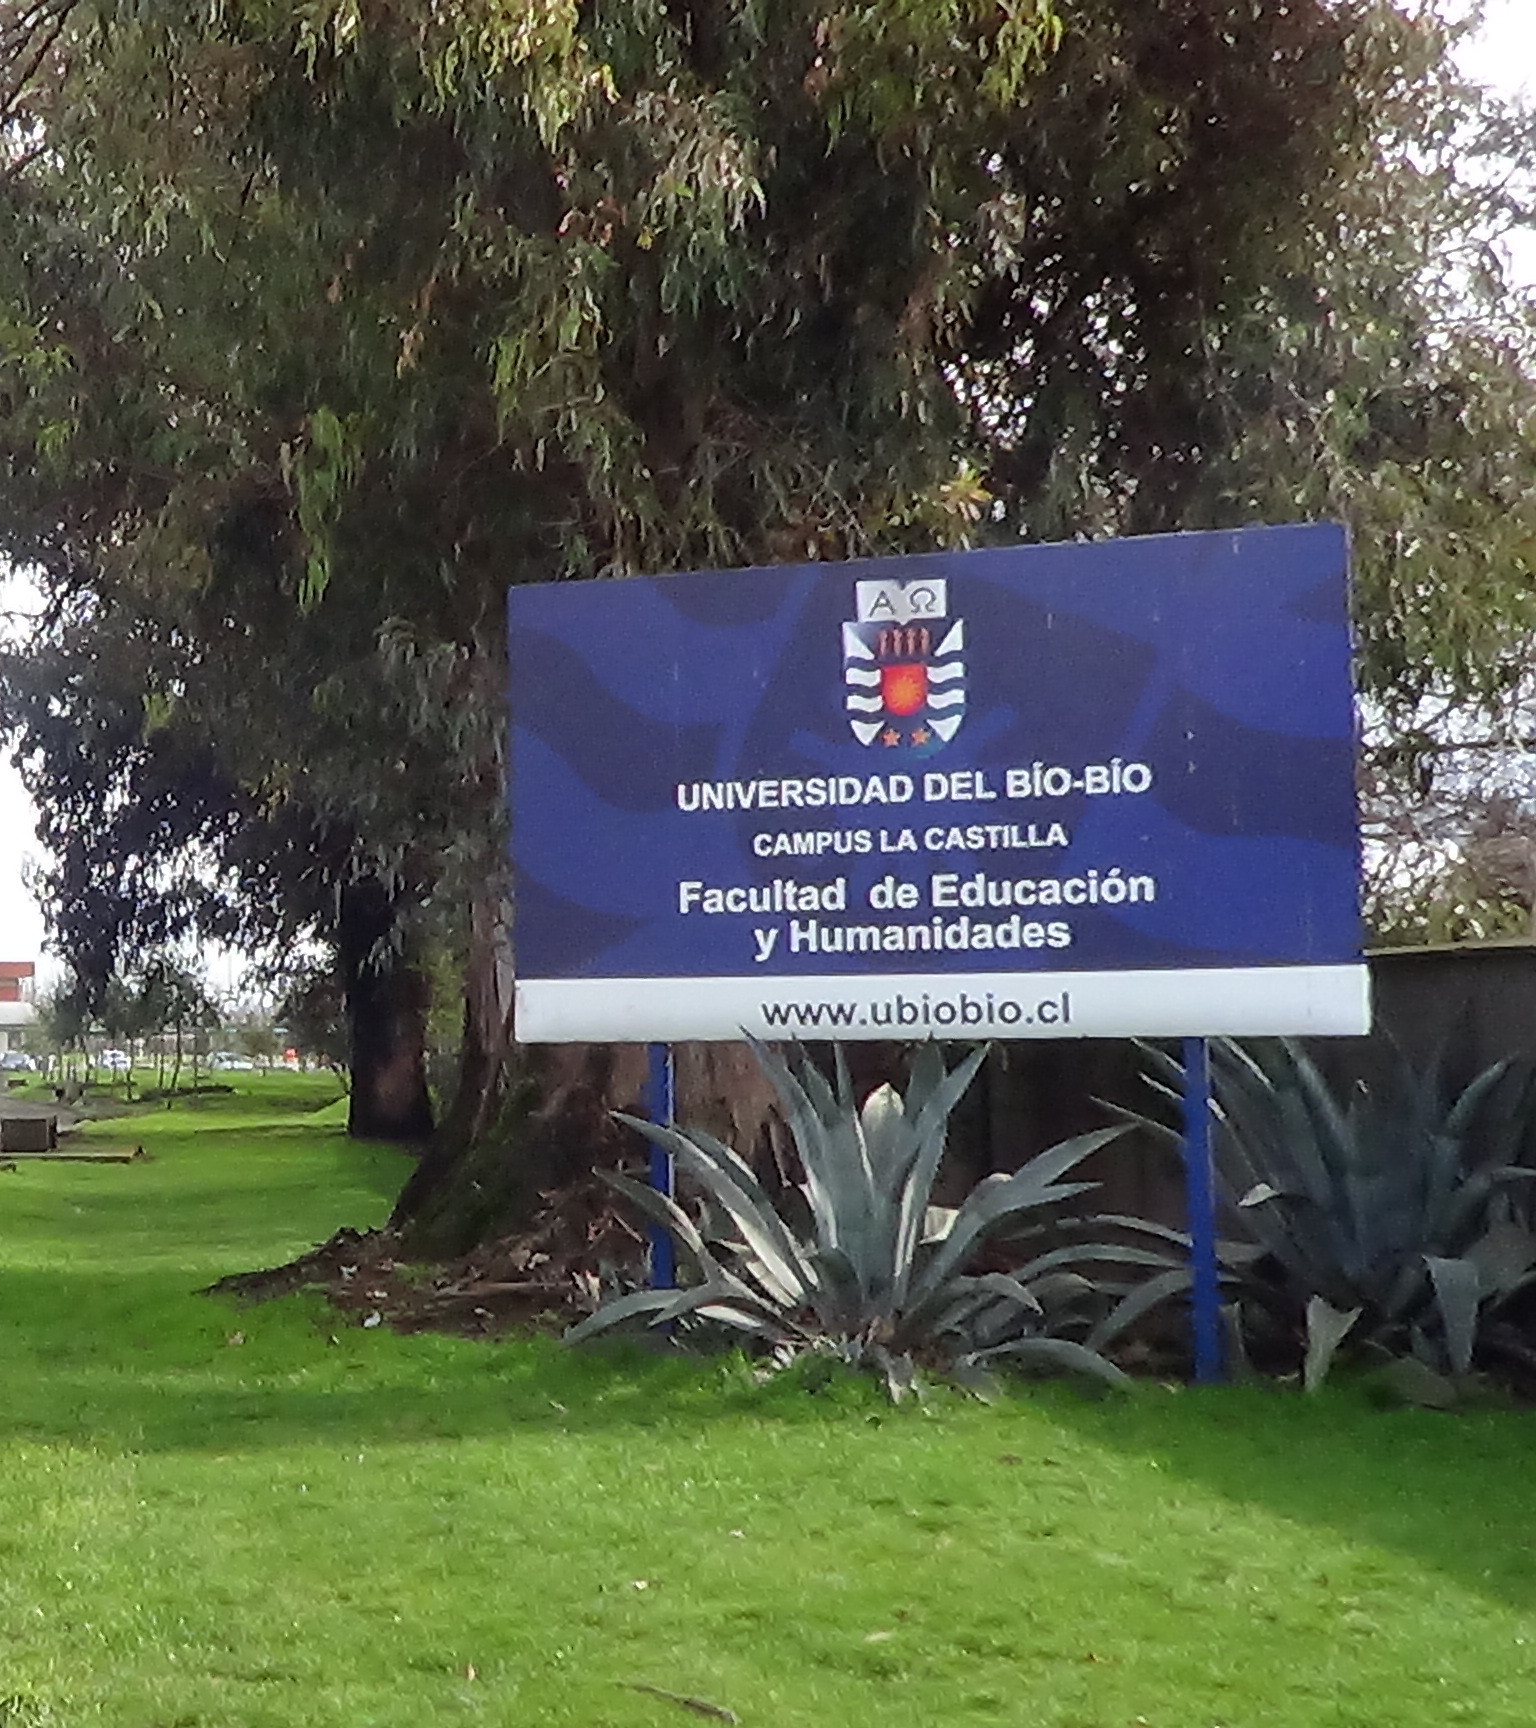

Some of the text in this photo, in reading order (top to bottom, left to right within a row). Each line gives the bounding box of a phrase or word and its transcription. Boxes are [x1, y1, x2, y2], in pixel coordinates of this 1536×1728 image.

[677, 758, 1153, 812] UNIVERSIDAD DEL BÍO-BÍO
[753, 823, 1069, 857] CAMPUS LA CASTILLA
[679, 868, 1156, 914] Facultad de Educación
[753, 915, 1071, 961] y Humanidades
[761, 991, 1071, 1027] www.ubiobio.cl
